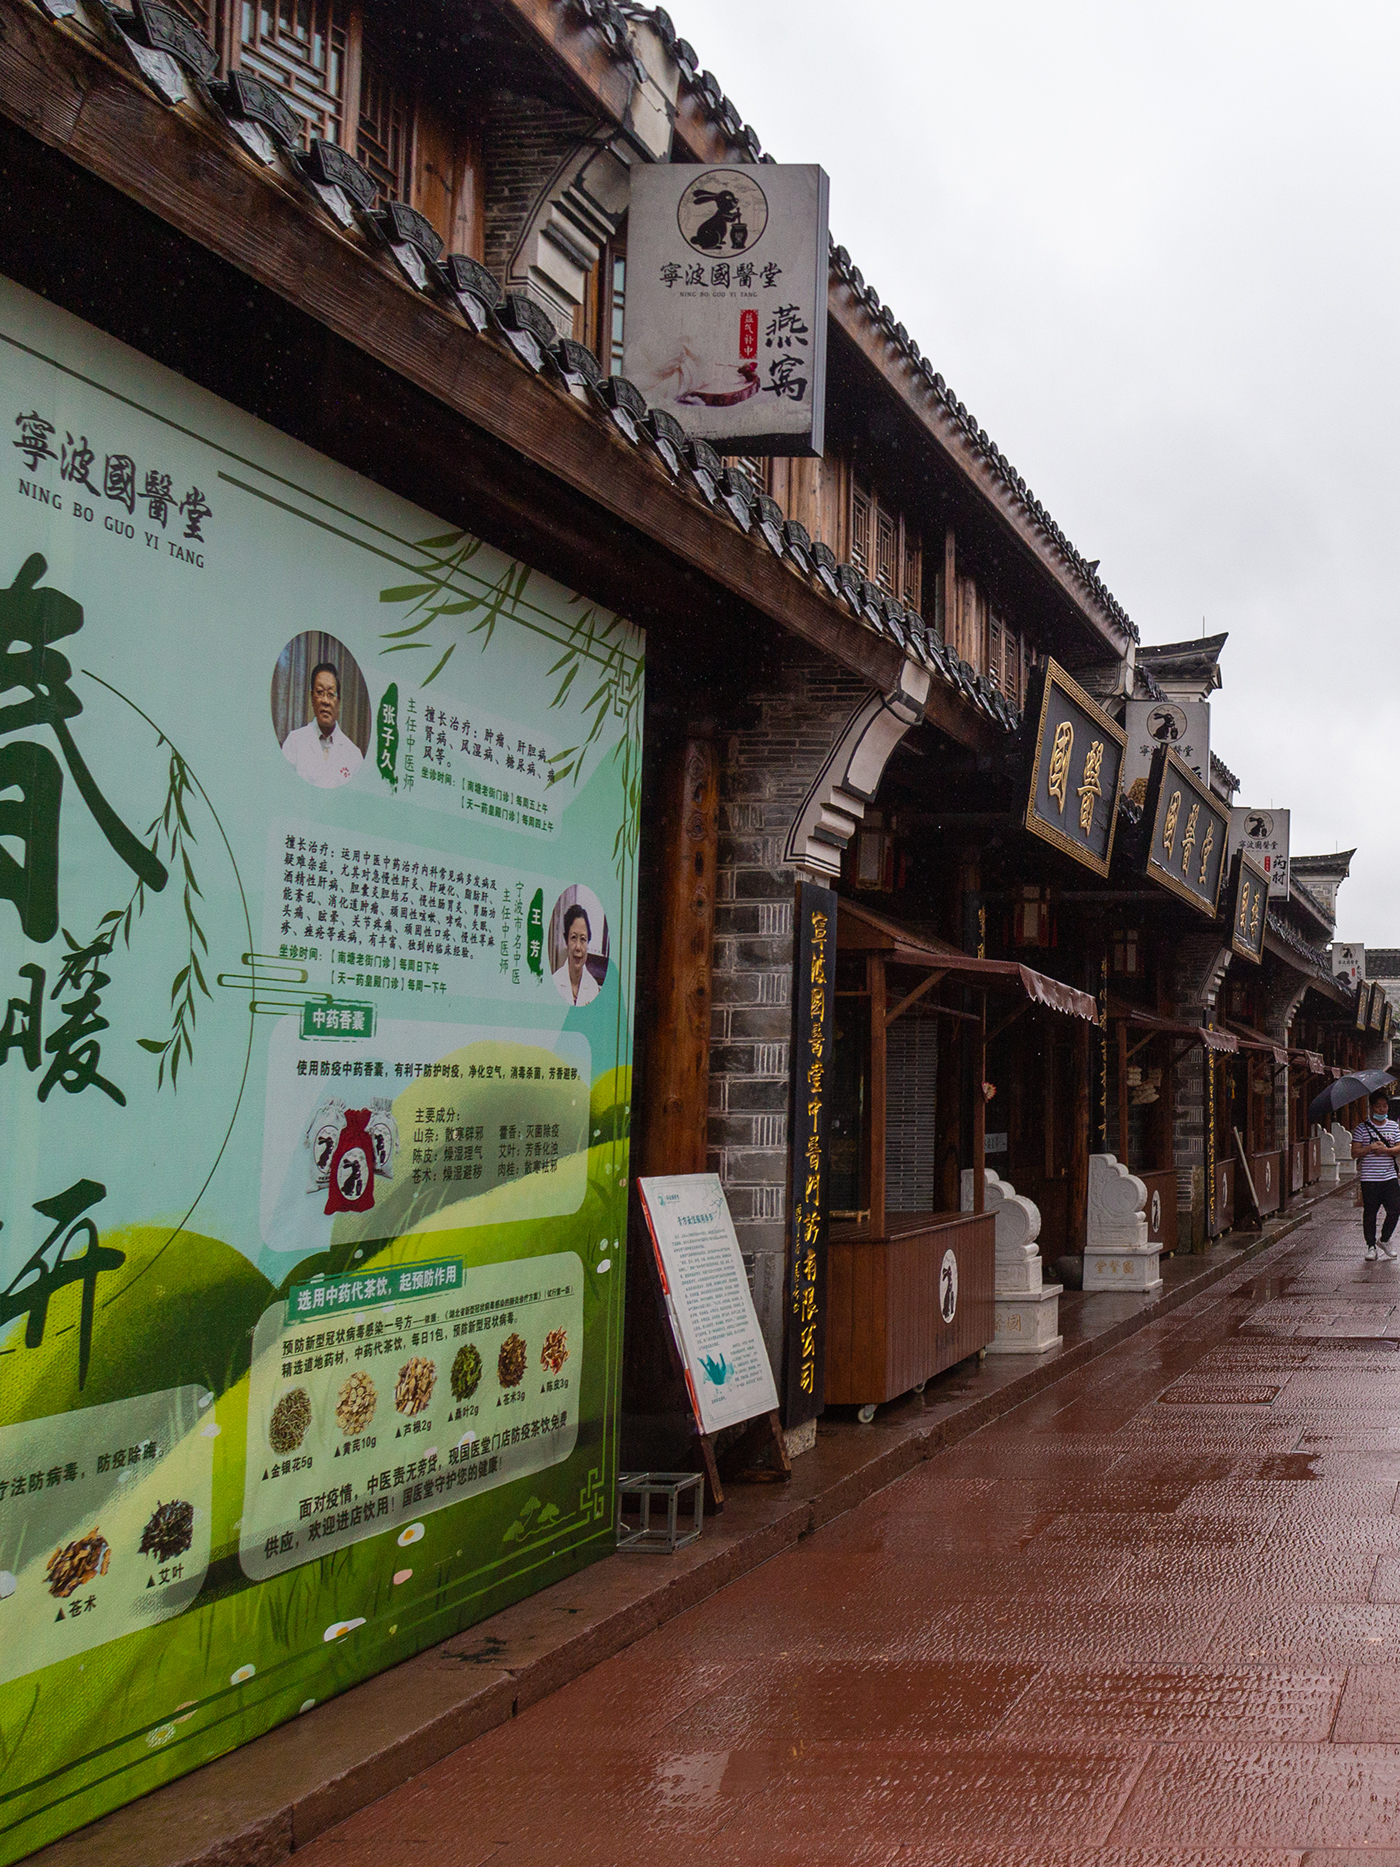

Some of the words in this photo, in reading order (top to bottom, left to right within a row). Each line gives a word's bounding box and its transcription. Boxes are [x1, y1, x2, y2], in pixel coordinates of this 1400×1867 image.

[658, 261, 783, 289] 寧波國醫堂
[12, 410, 213, 543] 寧波國醫堂
[18, 478, 63, 511] NING
[72, 501, 95, 523] BO
[103, 515, 136, 540] GUO
[144, 531, 160, 551] YI
[167, 540, 205, 569] TANG
[381, 703, 396, 771] 张子久
[402, 697, 418, 793] 主任中医师
[1272, 854, 1288, 886] 药材
[499, 887, 512, 975] 主任中医师
[510, 880, 525, 985] 宁波市名中医
[530, 907, 542, 958] 王芳
[312, 1008, 366, 1032] 中药香囊
[414, 1107, 461, 1124] 主要成分：
[297, 1265, 459, 1312] 选用中药代茶饮，起预防作用
[270, 1456, 314, 1480] 金银花5g
[158, 1562, 185, 1586] 艾叶
[68, 1594, 97, 1618] 苍术
